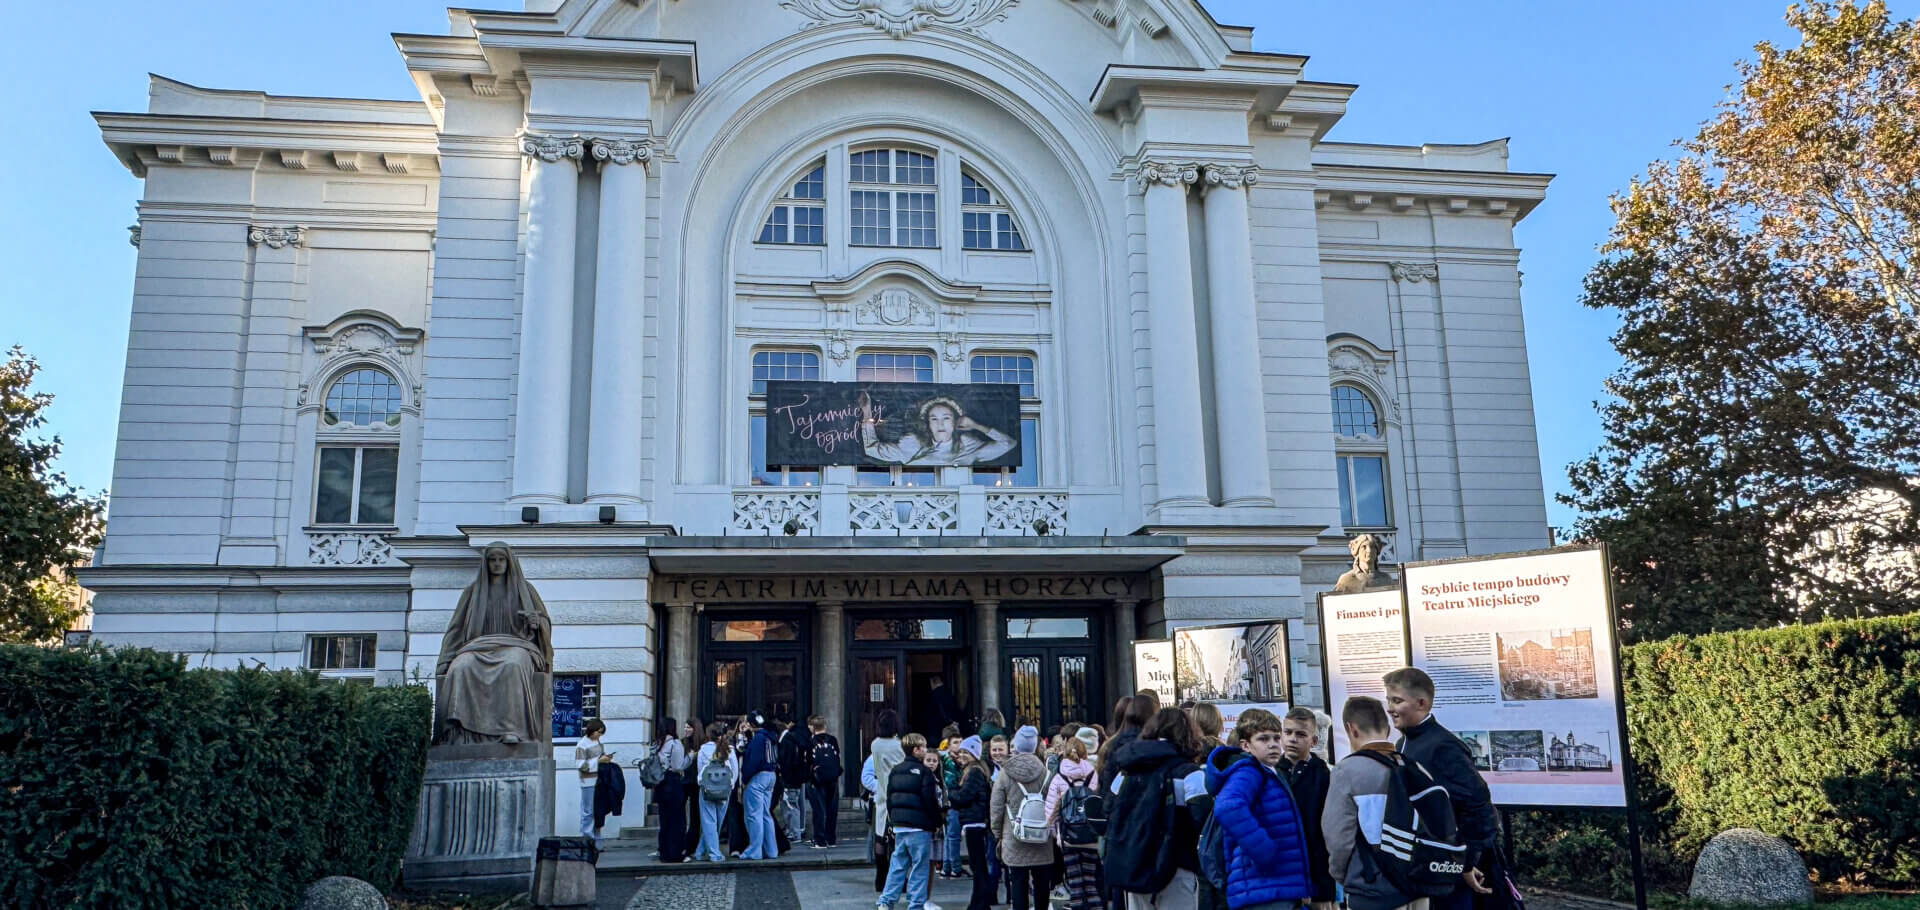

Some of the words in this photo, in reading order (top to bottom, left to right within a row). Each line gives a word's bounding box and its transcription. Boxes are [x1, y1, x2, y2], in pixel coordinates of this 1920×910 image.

[664, 578, 776, 599] TEATR
[844, 578, 971, 597] WILAMA
[983, 577, 1138, 597] HORZYCY
[1421, 581, 1470, 597] Szybkie
[1473, 579, 1514, 592] tempo
[1516, 573, 1571, 587] budowy
[1422, 599, 1465, 611] Teatru
[1467, 593, 1540, 609] Miejskiego
[1336, 609, 1377, 620] Finanse
[1429, 860, 1464, 873] adidas
